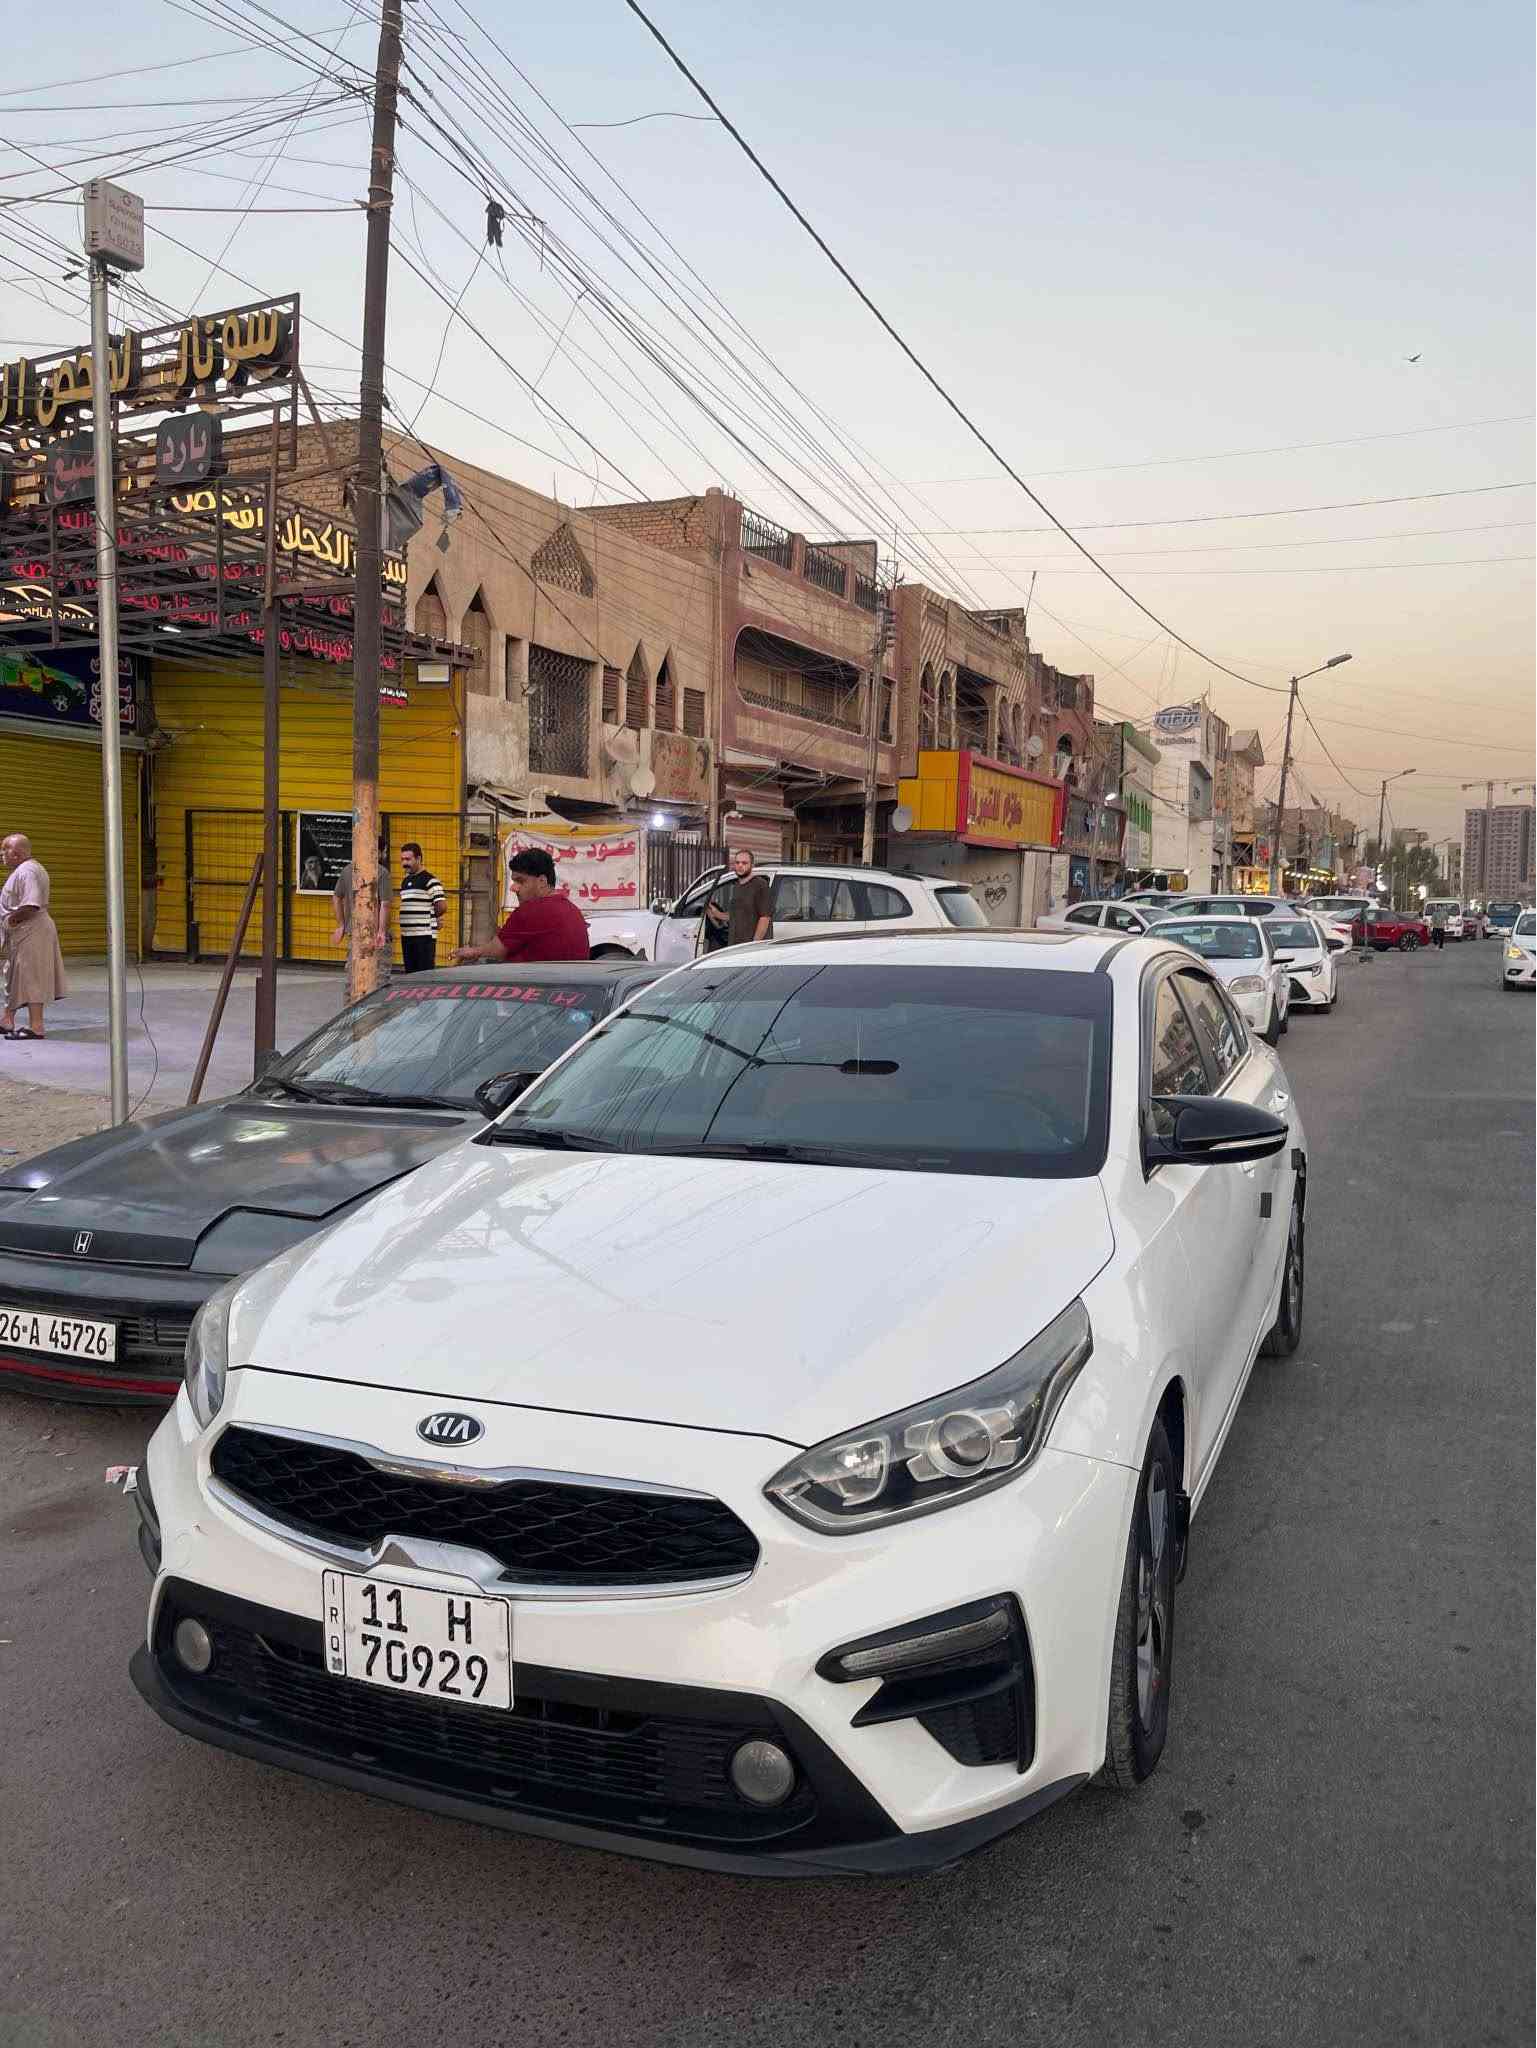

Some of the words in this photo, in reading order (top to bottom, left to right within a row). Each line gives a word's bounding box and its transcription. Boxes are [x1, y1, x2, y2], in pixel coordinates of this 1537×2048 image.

[175, 309, 279, 388] سونار
[579, 876, 637, 903] عقود
[385, 984, 545, 1003] PRELUDE
[50, 1319, 108, 1357] 45726
[423, 1415, 471, 1441] KIA
[361, 1583, 409, 1634] 11
[447, 1598, 472, 1645] H
[360, 1632, 488, 1699] 70929
